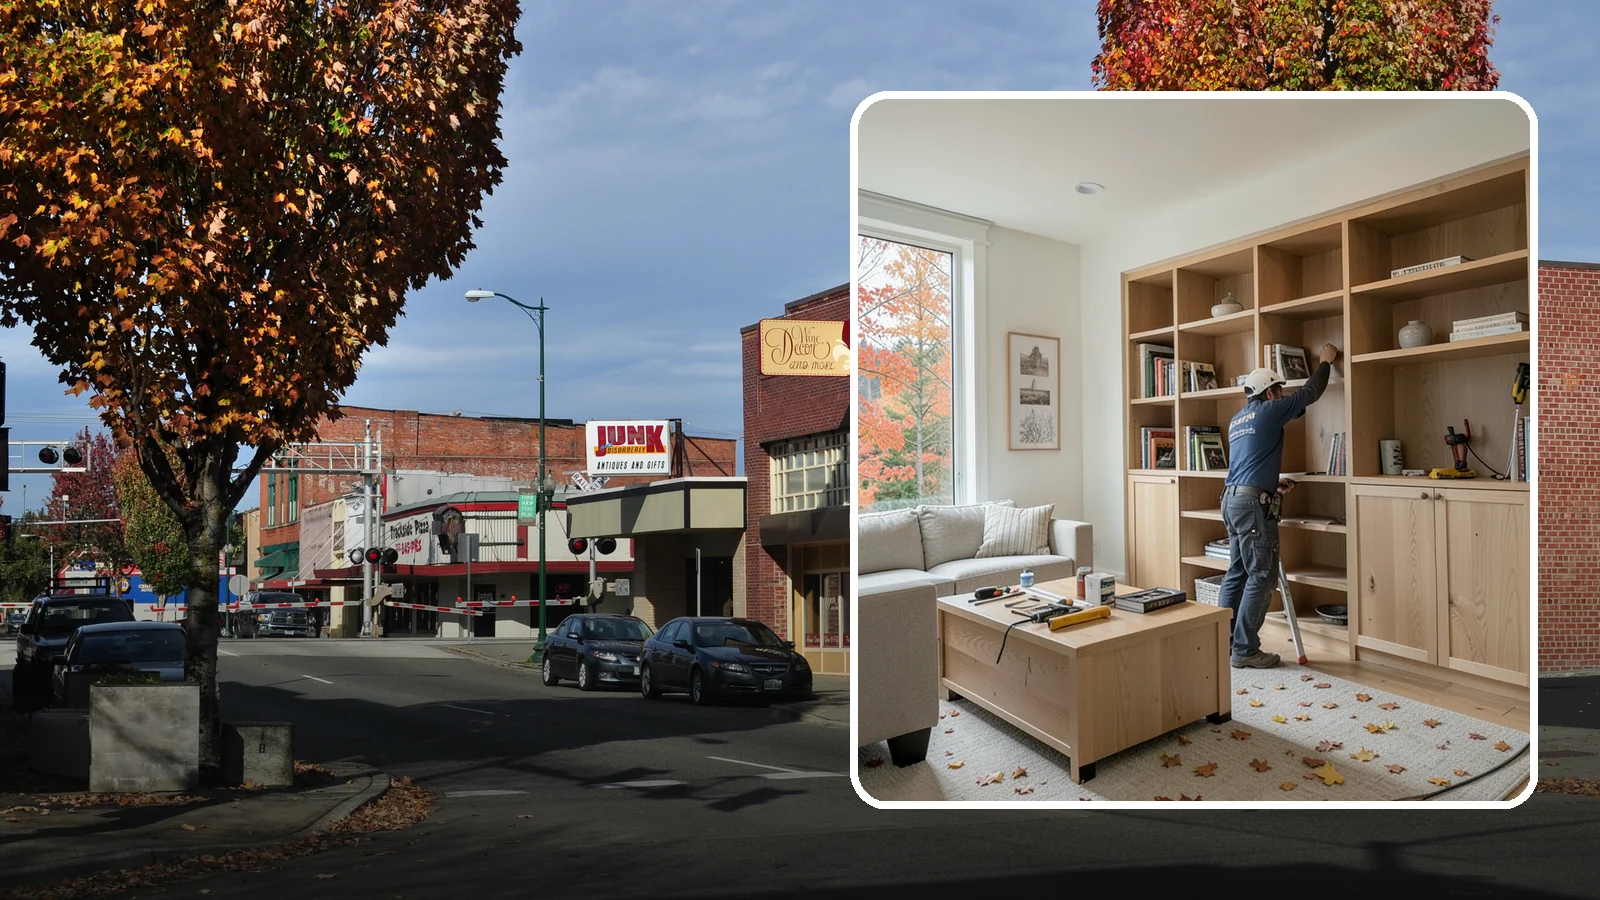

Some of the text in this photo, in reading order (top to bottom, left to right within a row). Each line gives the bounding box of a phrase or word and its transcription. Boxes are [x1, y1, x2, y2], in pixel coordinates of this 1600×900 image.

[596, 425, 665, 457] JUNK
[607, 446, 646, 454] DISORDERLY
[597, 460, 665, 470] ANTIQUES AND GIFTS
[390, 519, 429, 540] Trackside Pizza
